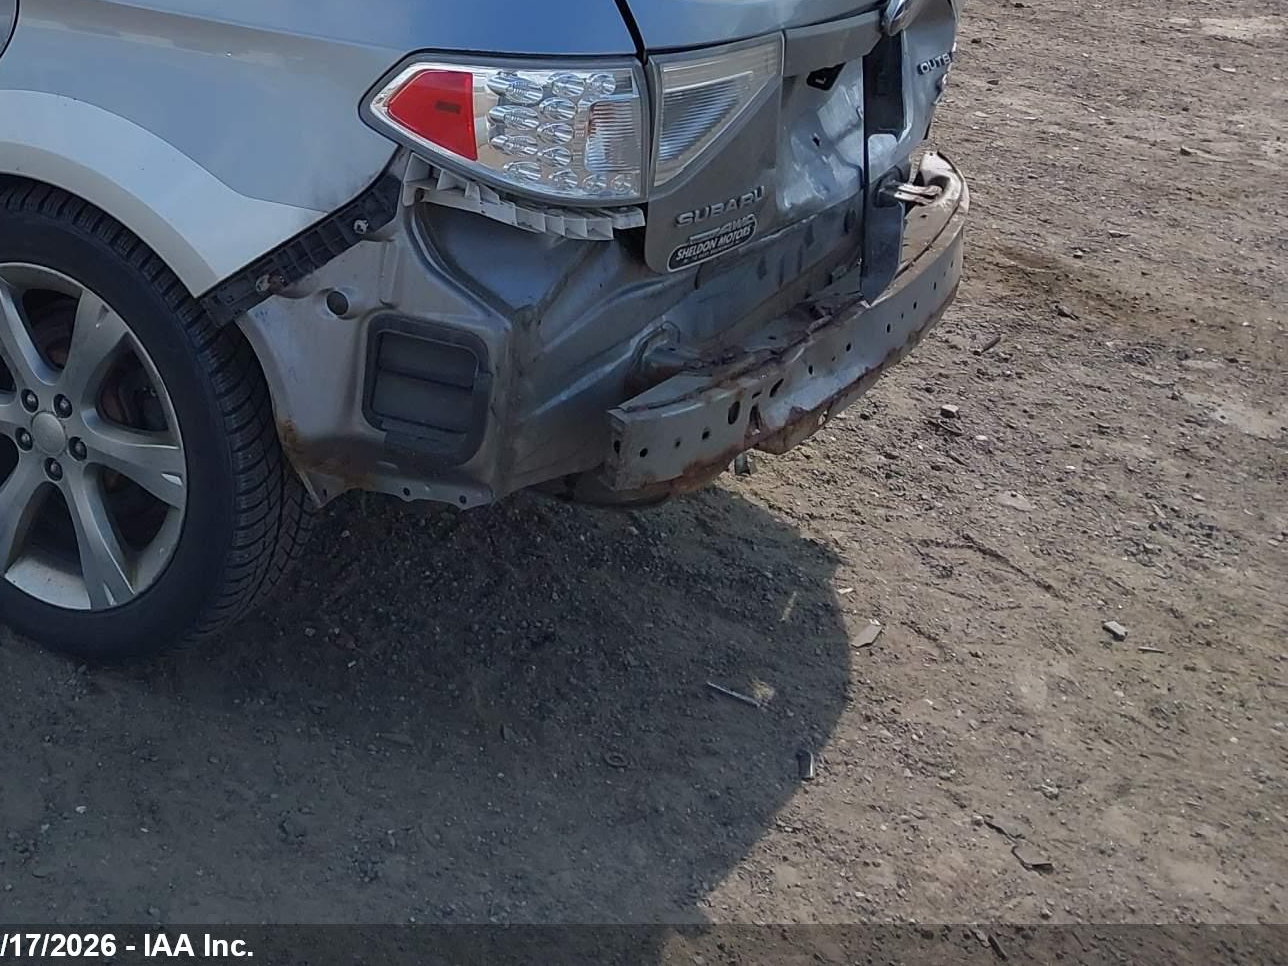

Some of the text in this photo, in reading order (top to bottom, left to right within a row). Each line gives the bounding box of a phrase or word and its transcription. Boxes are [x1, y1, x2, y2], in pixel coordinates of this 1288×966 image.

[919, 52, 952, 73] OUTB
[675, 186, 764, 227] SUBARU
[676, 236, 718, 260] SHELDON
[718, 225, 751, 248] MOTORS
